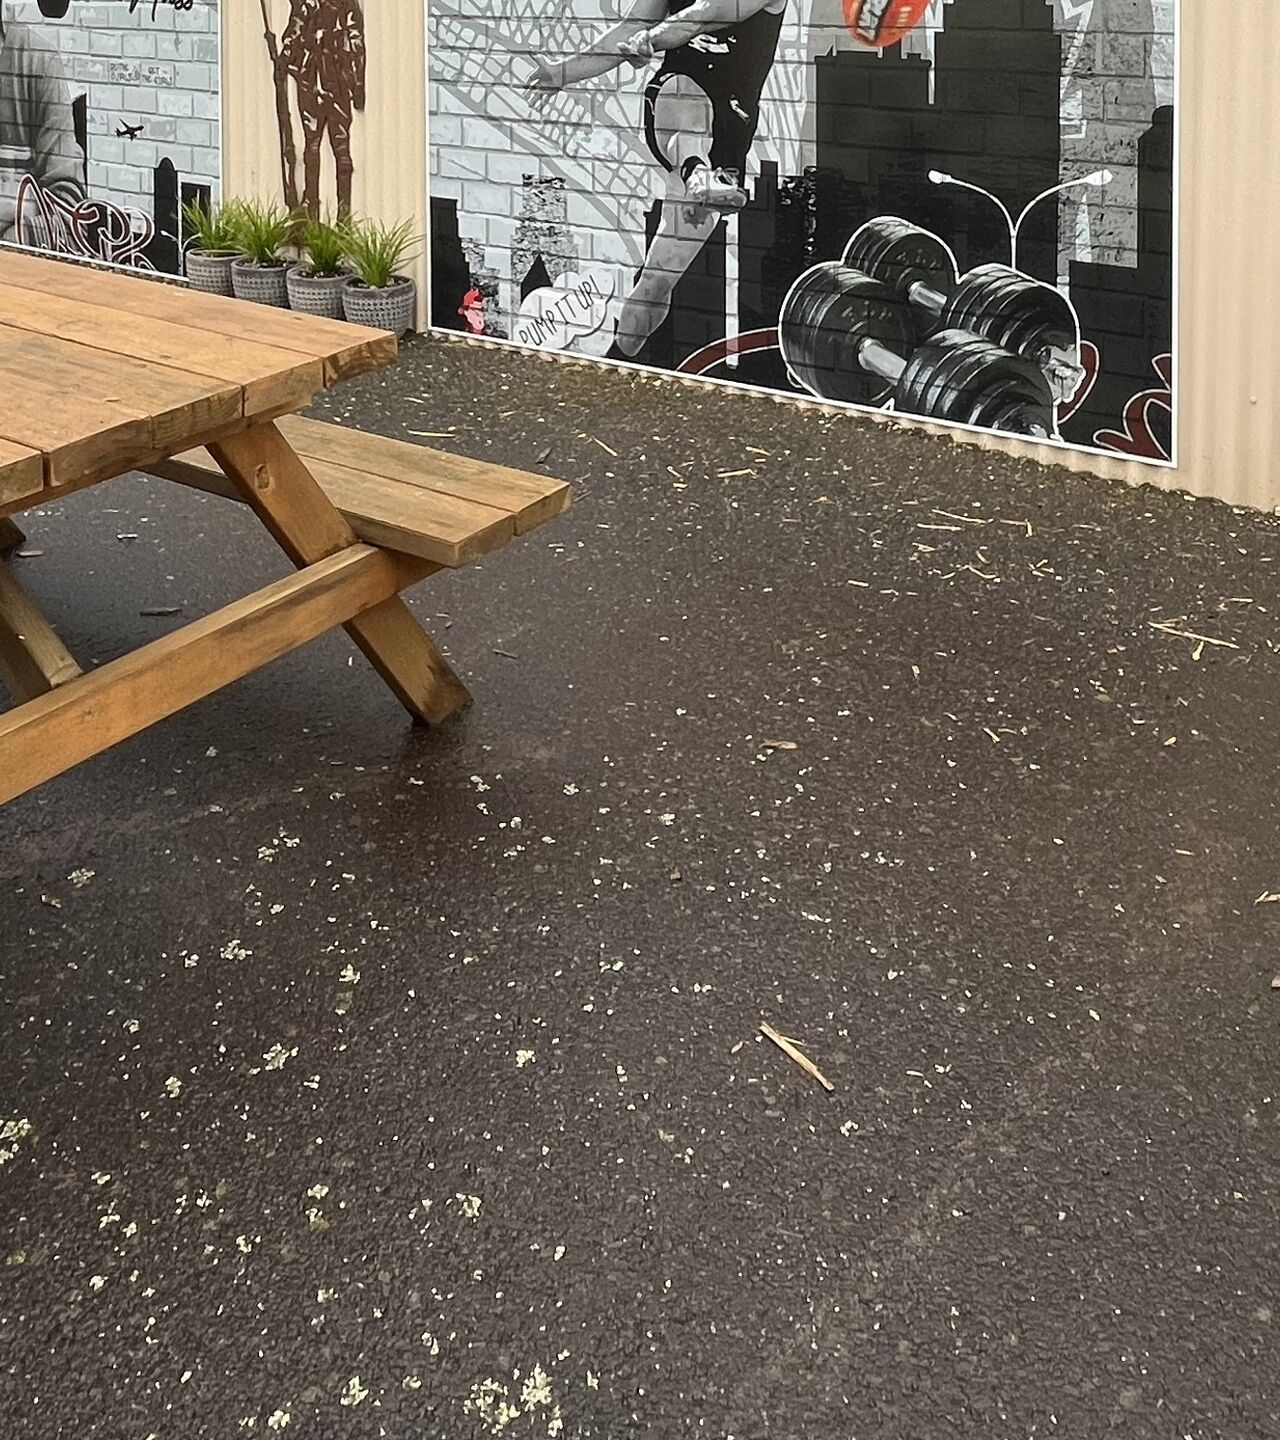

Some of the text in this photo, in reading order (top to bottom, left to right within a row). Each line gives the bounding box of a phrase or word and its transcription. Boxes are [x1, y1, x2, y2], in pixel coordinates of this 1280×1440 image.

[519, 274, 603, 346] PUMP IT UP!
